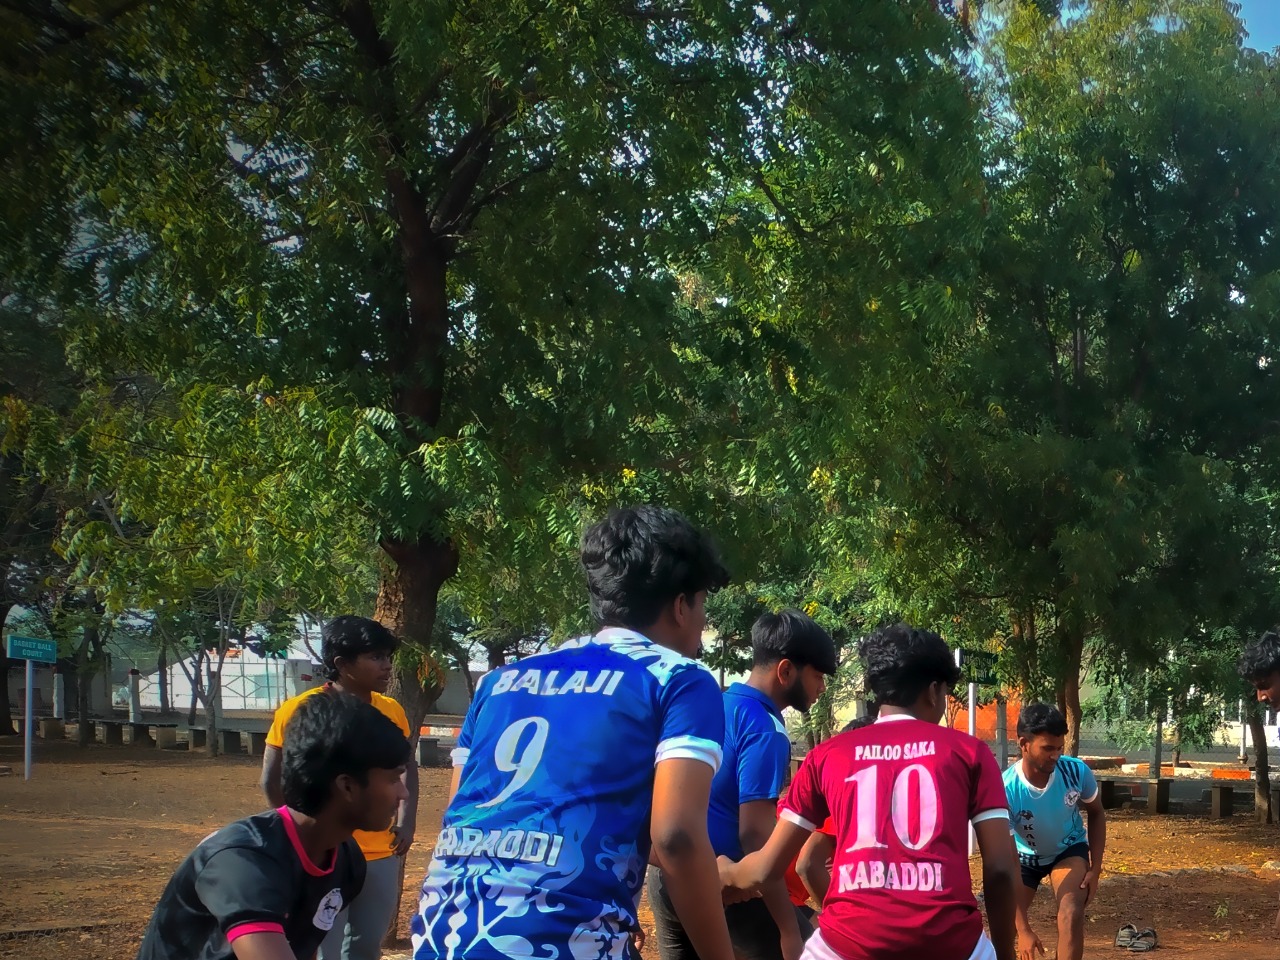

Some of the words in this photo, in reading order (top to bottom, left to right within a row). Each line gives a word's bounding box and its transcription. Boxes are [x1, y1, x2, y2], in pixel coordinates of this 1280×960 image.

[14, 640, 36, 649] BASKET
[22, 649, 43, 657] COURT
[491, 669, 624, 696] BALAJI
[475, 716, 549, 808] 9
[855, 745, 901, 760] PAILOO
[903, 741, 935, 760] SAKA
[845, 764, 937, 853] 10
[838, 861, 943, 894] KABADDI
